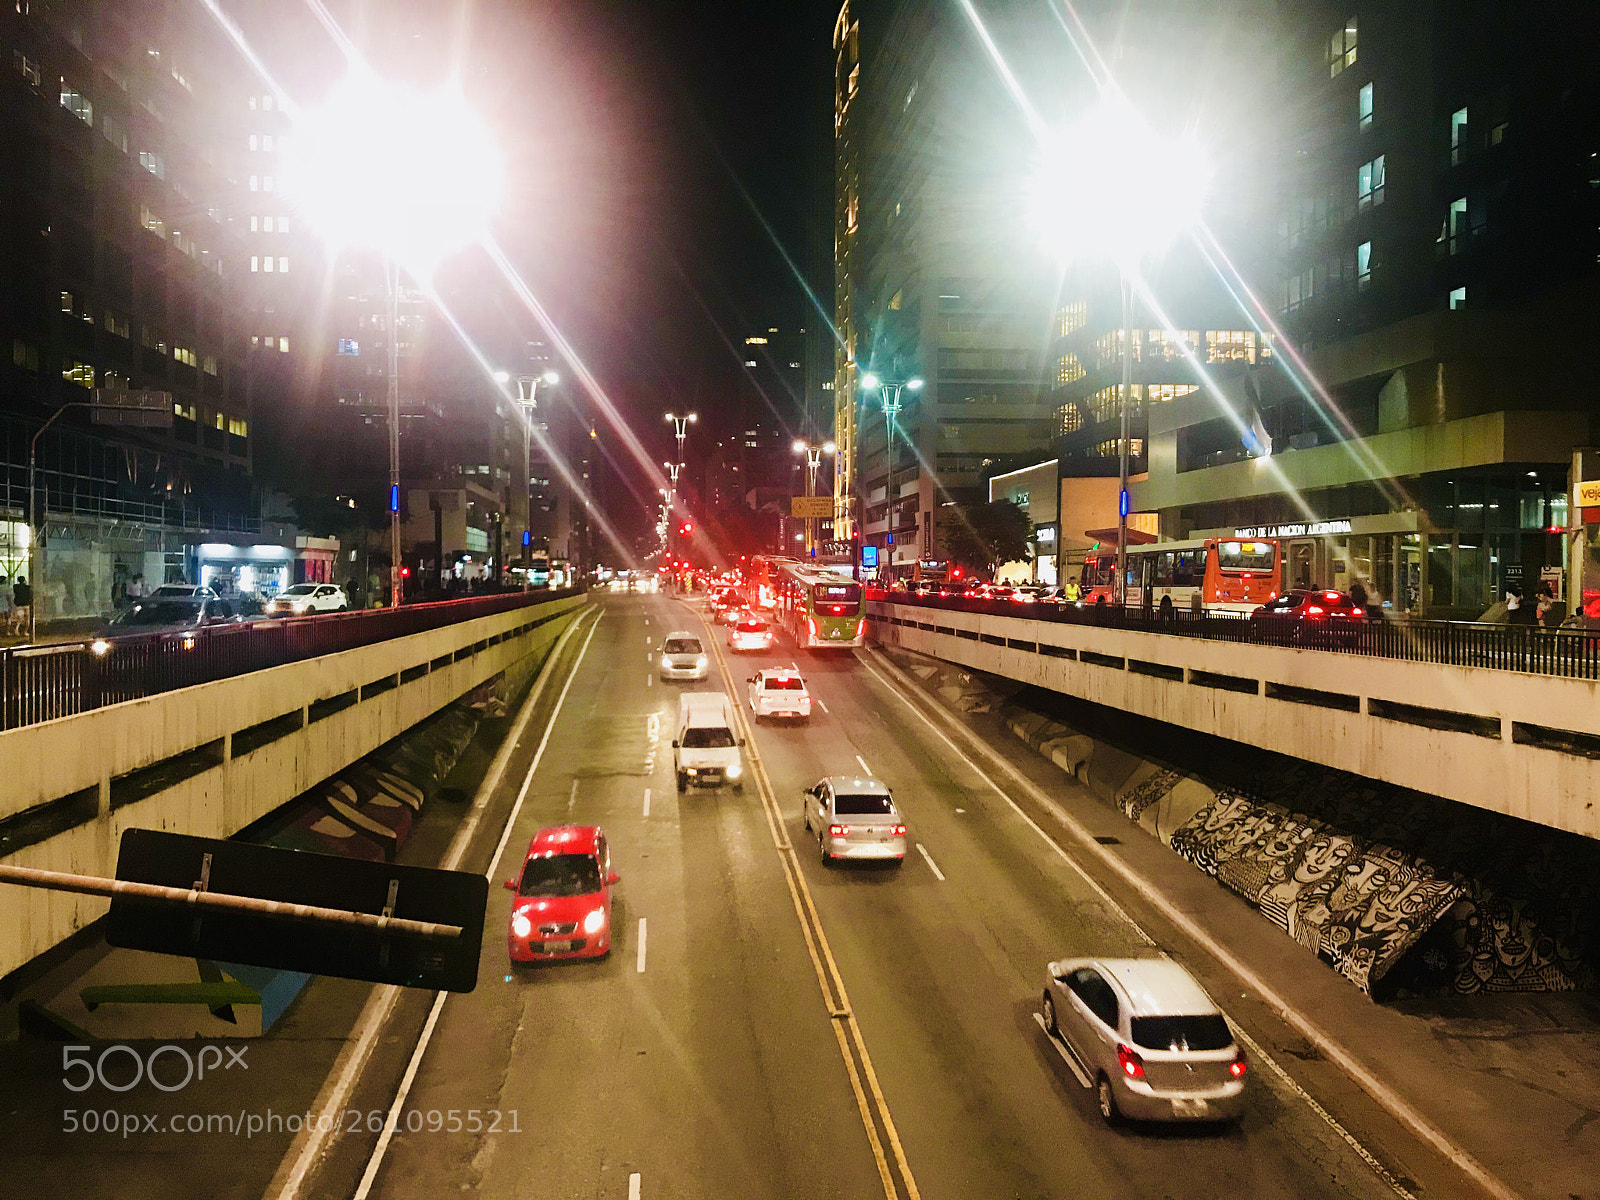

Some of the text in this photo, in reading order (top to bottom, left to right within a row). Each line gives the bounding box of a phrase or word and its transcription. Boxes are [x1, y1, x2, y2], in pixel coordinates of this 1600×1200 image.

[1235, 528, 1256, 538] BANCO
[1257, 527, 1267, 538] DE
[1268, 526, 1277, 537] LA
[1307, 521, 1352, 535] ARGENTINA
